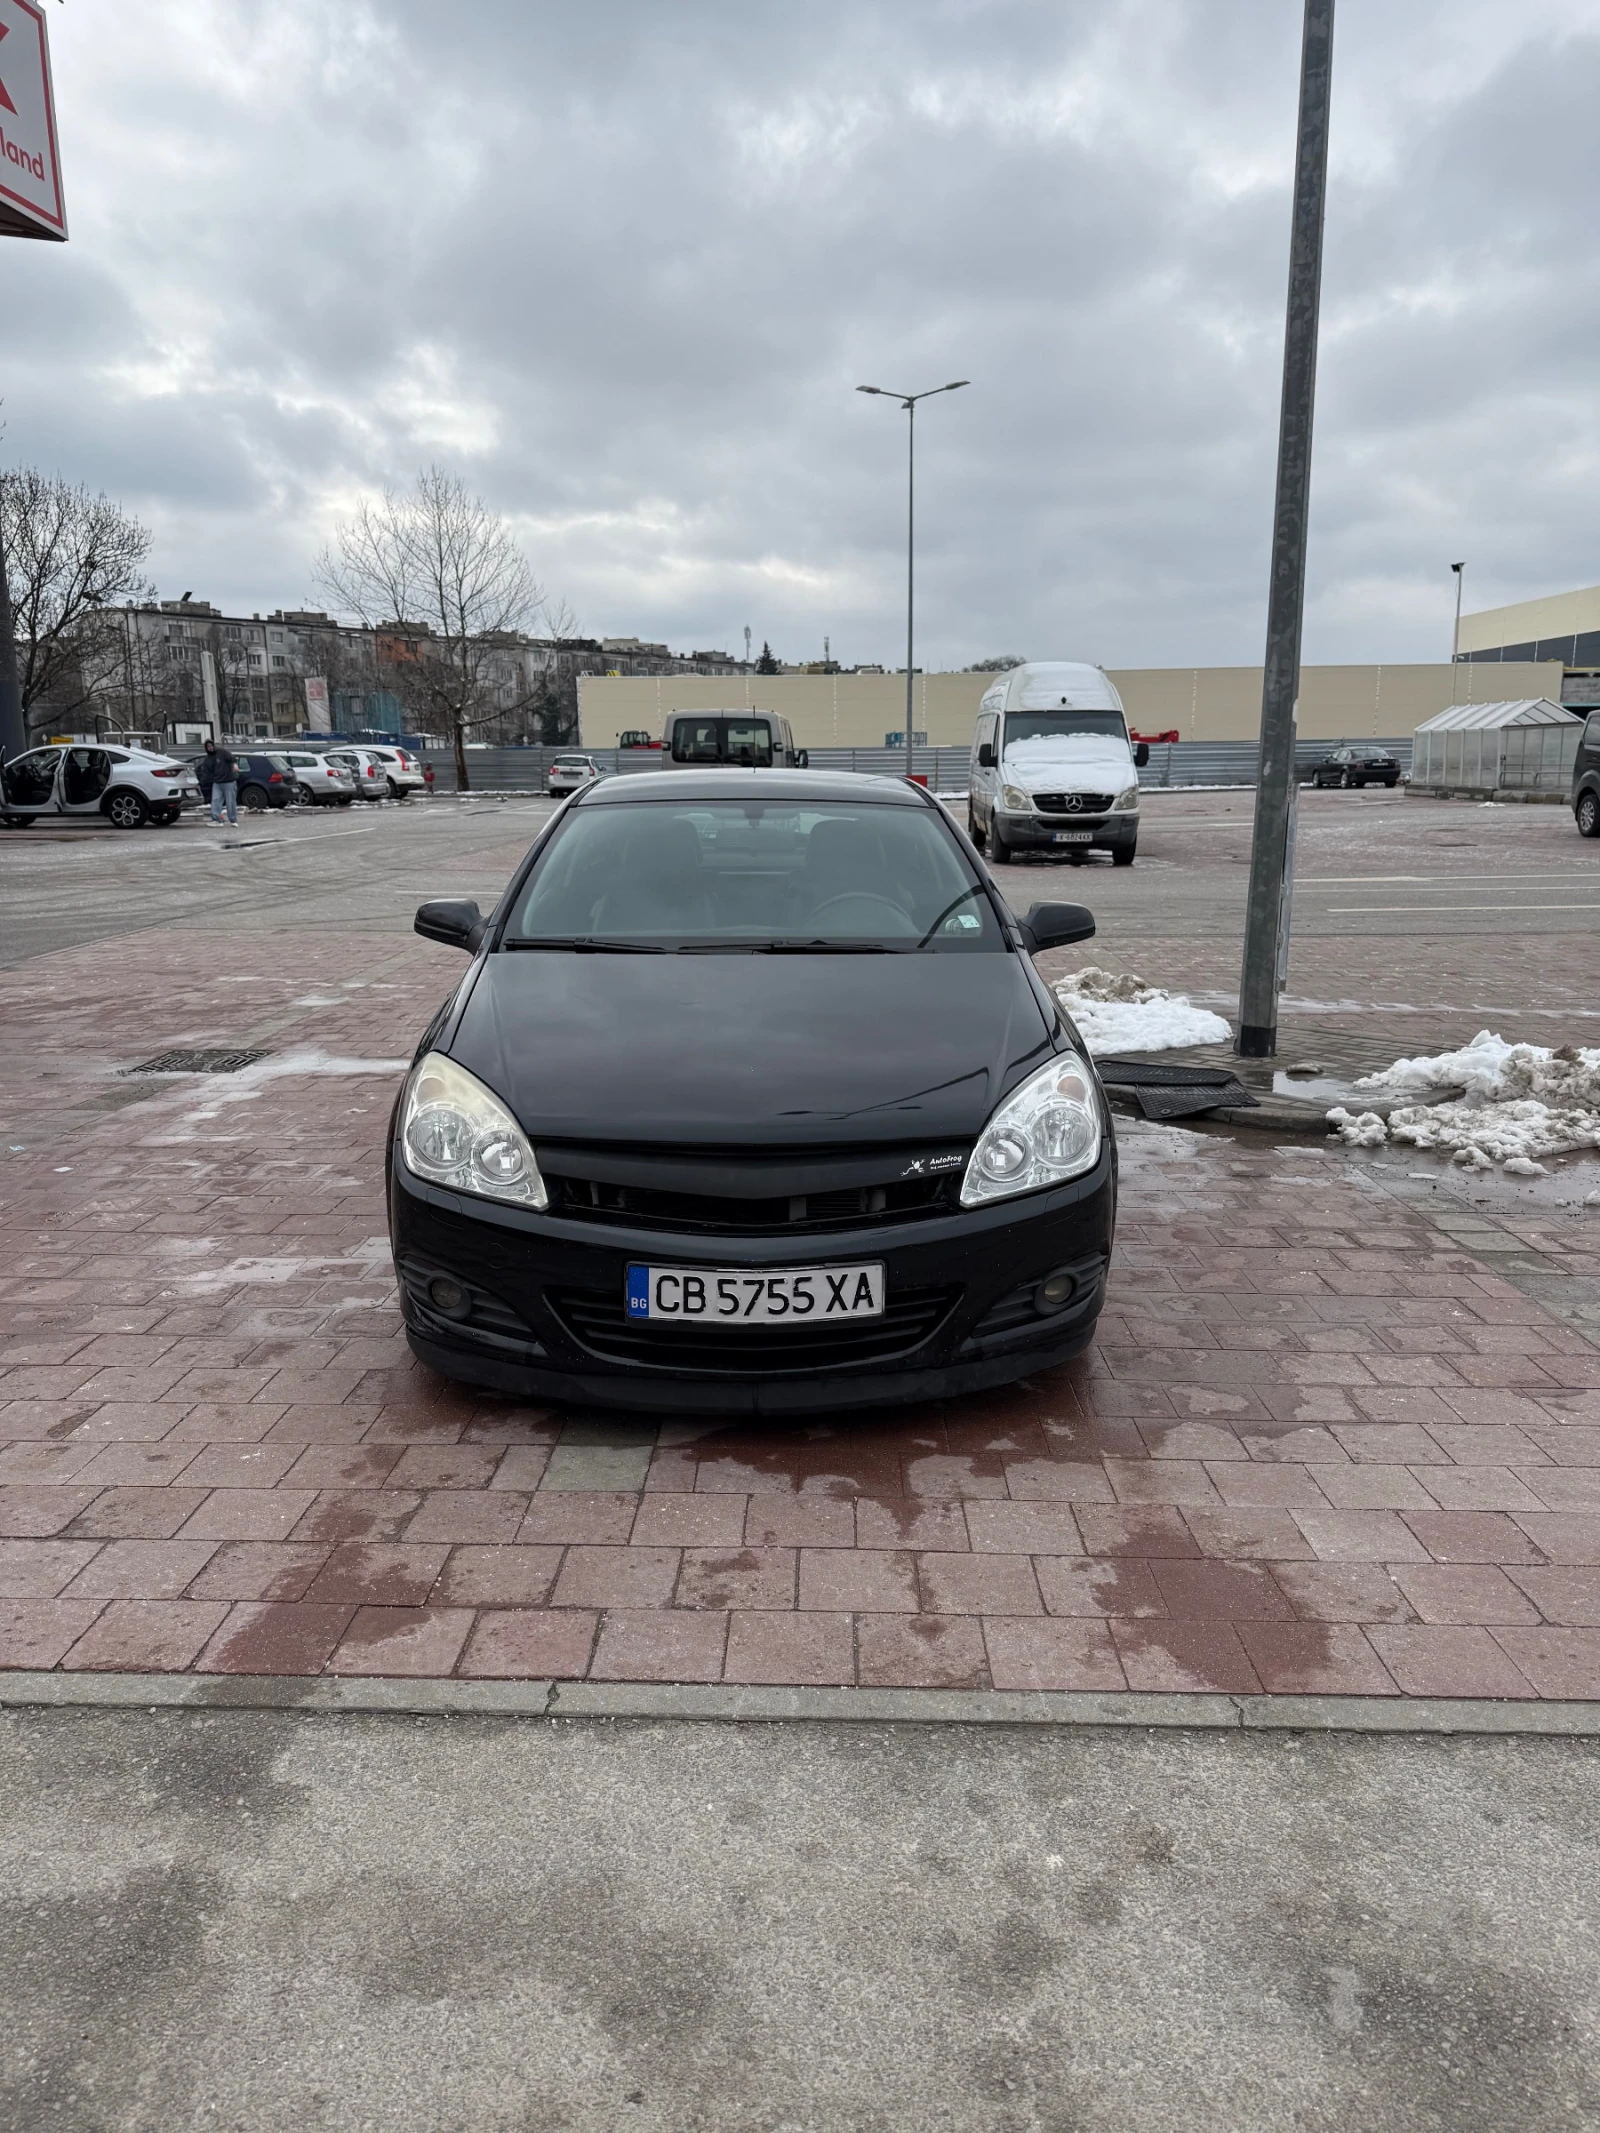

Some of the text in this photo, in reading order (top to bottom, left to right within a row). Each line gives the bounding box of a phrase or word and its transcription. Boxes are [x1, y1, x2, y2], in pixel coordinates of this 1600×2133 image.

[630, 1297, 647, 1309] BG
[656, 1272, 875, 1316] CB 5755 XA
